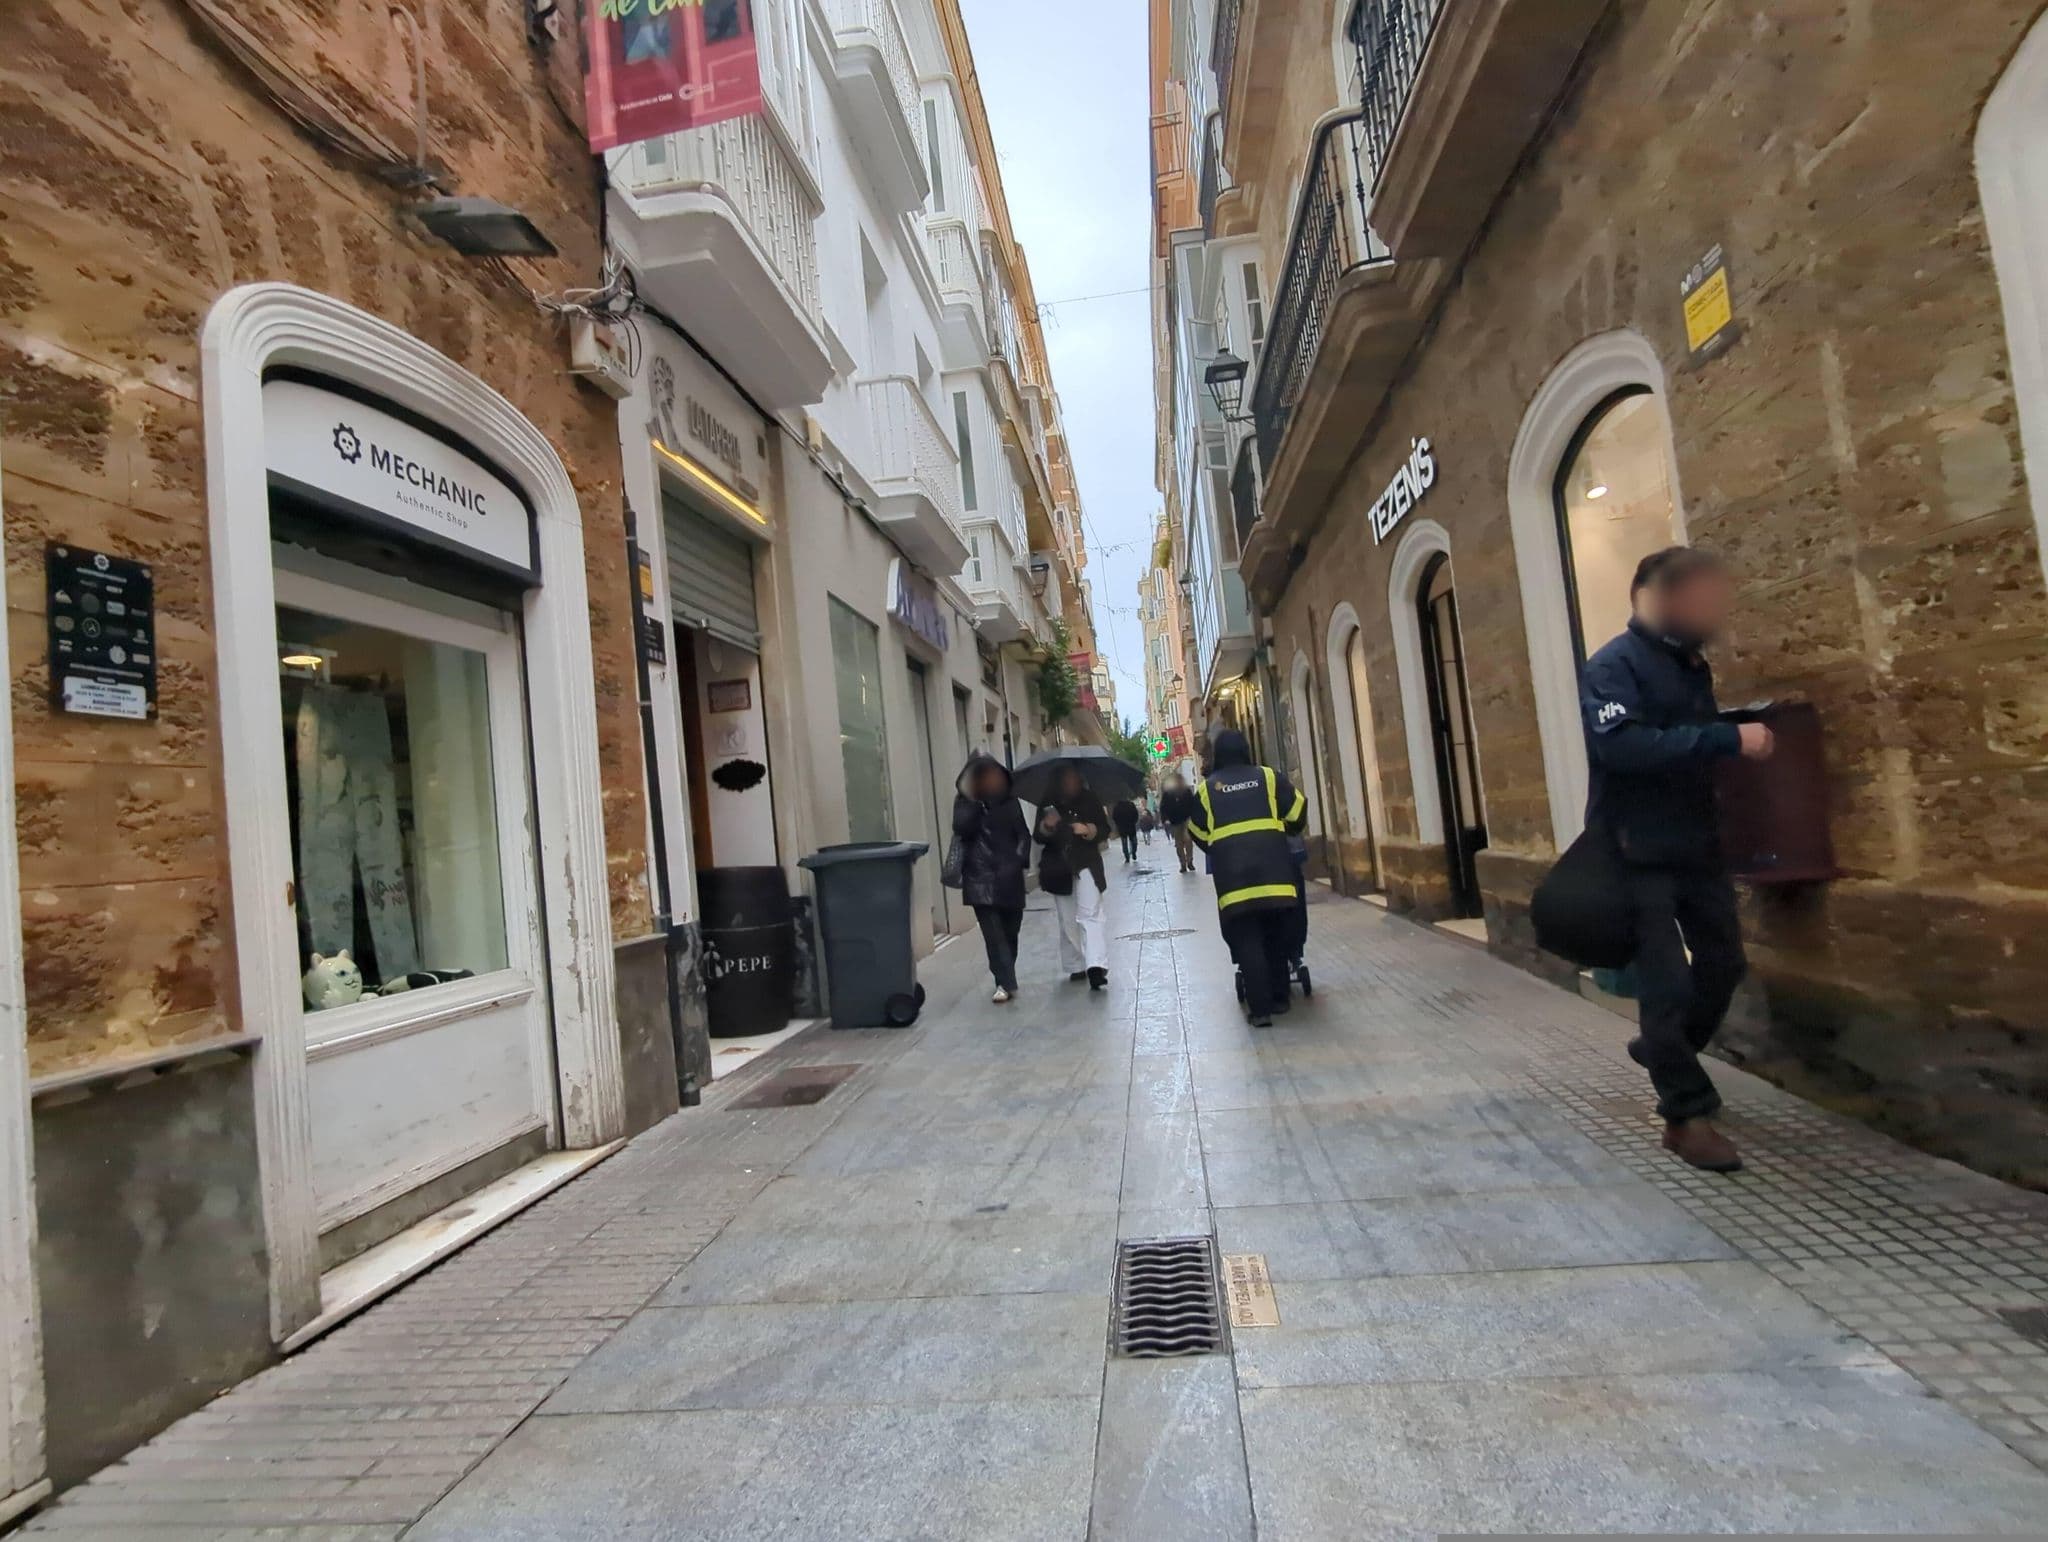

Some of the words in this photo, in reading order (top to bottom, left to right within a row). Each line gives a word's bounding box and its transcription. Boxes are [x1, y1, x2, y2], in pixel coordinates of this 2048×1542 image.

[371, 443, 487, 516] MECHANIC
[396, 490, 445, 519] Authentic
[447, 511, 469, 530] Shop
[1222, 779, 1259, 793] CORREOS
[724, 954, 773, 975] PEPE
